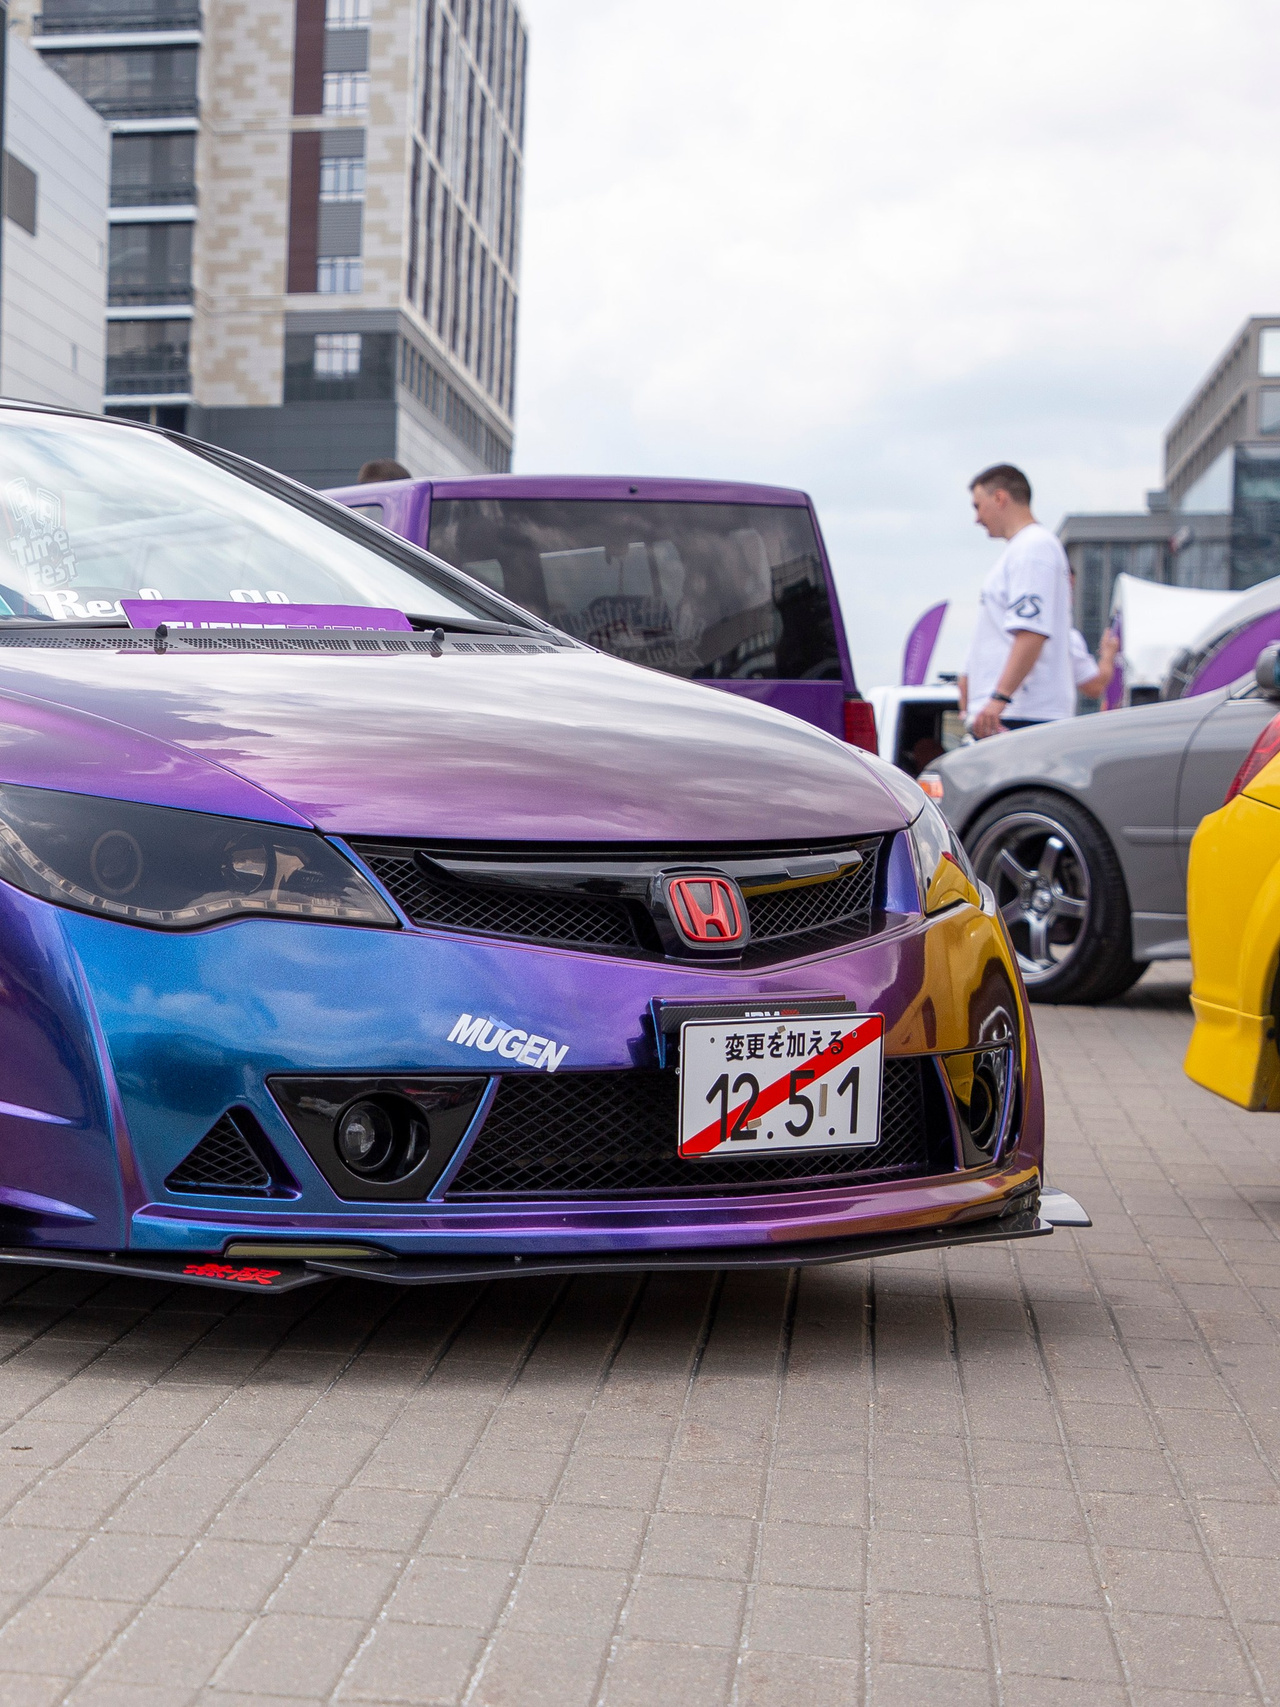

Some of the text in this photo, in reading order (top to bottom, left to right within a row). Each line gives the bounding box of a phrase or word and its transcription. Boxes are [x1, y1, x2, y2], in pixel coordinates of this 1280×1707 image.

[447, 1013, 570, 1073] MUGEN
[725, 1029, 845, 1062] 変更を加える
[706, 1066, 860, 1142] 12.5.1
